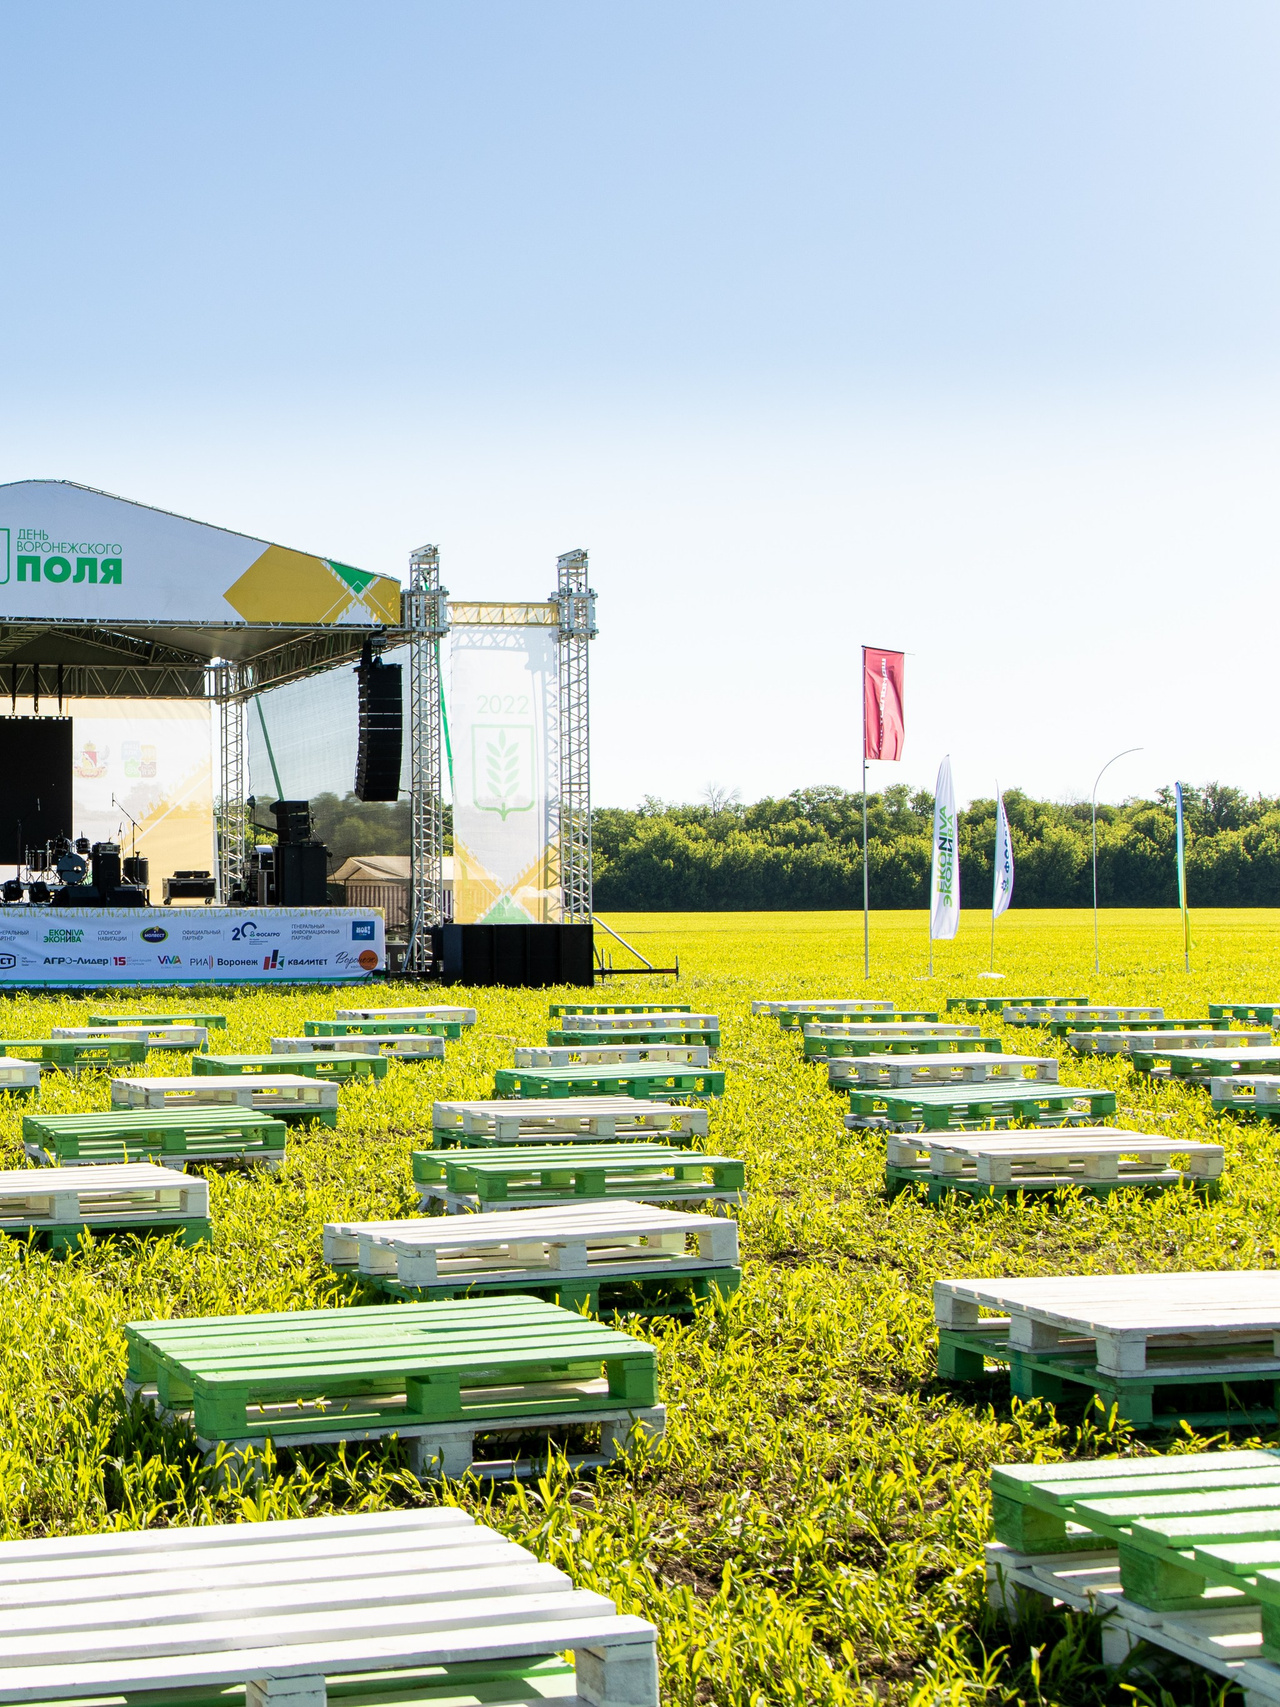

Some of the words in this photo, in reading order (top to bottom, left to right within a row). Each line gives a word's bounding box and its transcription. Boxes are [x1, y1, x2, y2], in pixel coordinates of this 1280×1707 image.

[17, 529, 49, 541] ДЕНЬ
[16, 541, 123, 555] ВОРОНЕЖСКОГО
[17, 555, 123, 584] ПОЛЯ
[477, 695, 529, 715] 2022
[936, 805, 948, 893] EKONIVA
[943, 814, 954, 908] ЭКОНИВА
[43, 957, 109, 966] АГРО-Лидер
[113, 957, 127, 966] 15
[190, 958, 209, 966] РИА
[217, 958, 258, 966] Воронеж
